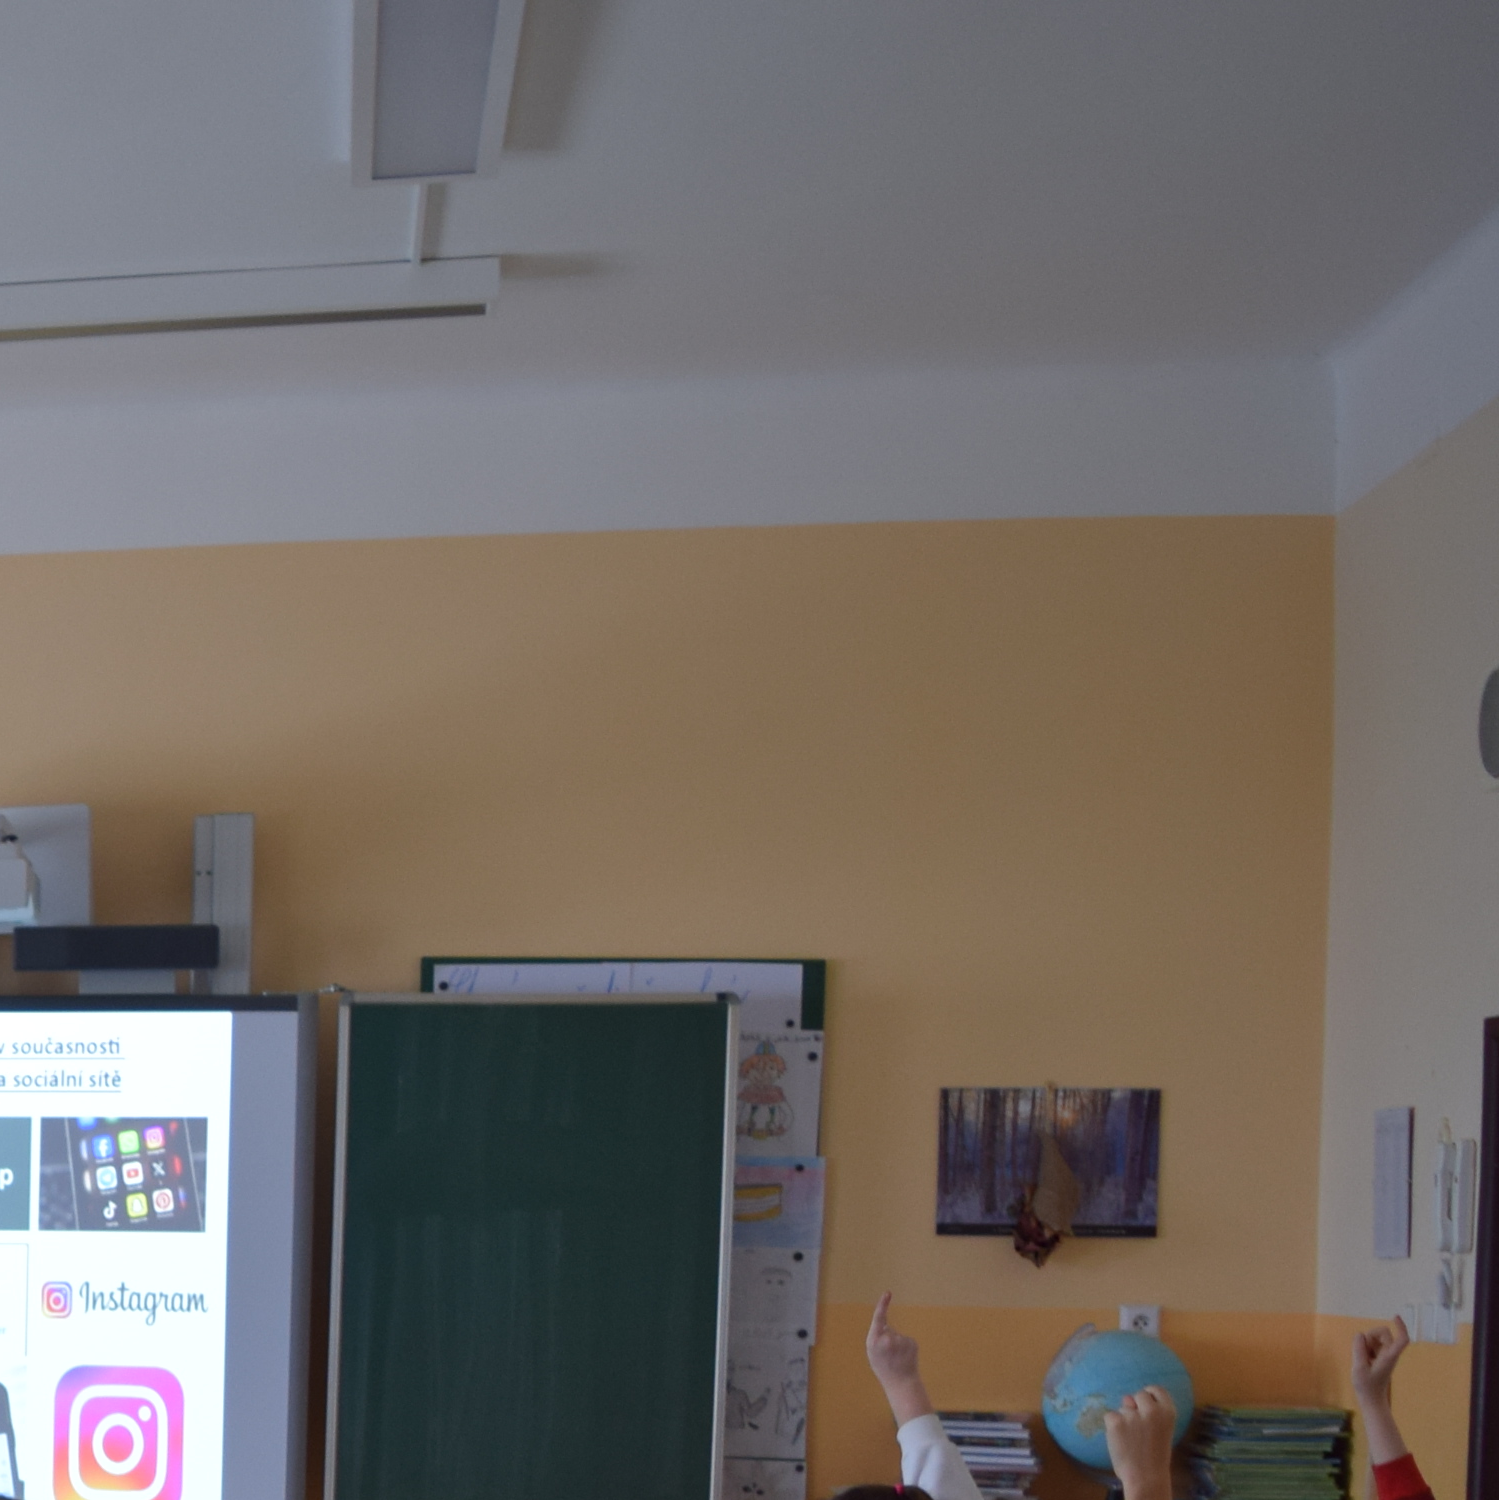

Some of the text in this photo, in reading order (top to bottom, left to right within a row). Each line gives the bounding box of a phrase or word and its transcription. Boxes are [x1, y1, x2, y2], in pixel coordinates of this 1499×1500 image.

[12, 1037, 120, 1055] současnosti
[13, 1070, 83, 1088] sociální
[89, 1070, 121, 1088] sítě
[79, 1281, 208, 1326] Instagram
